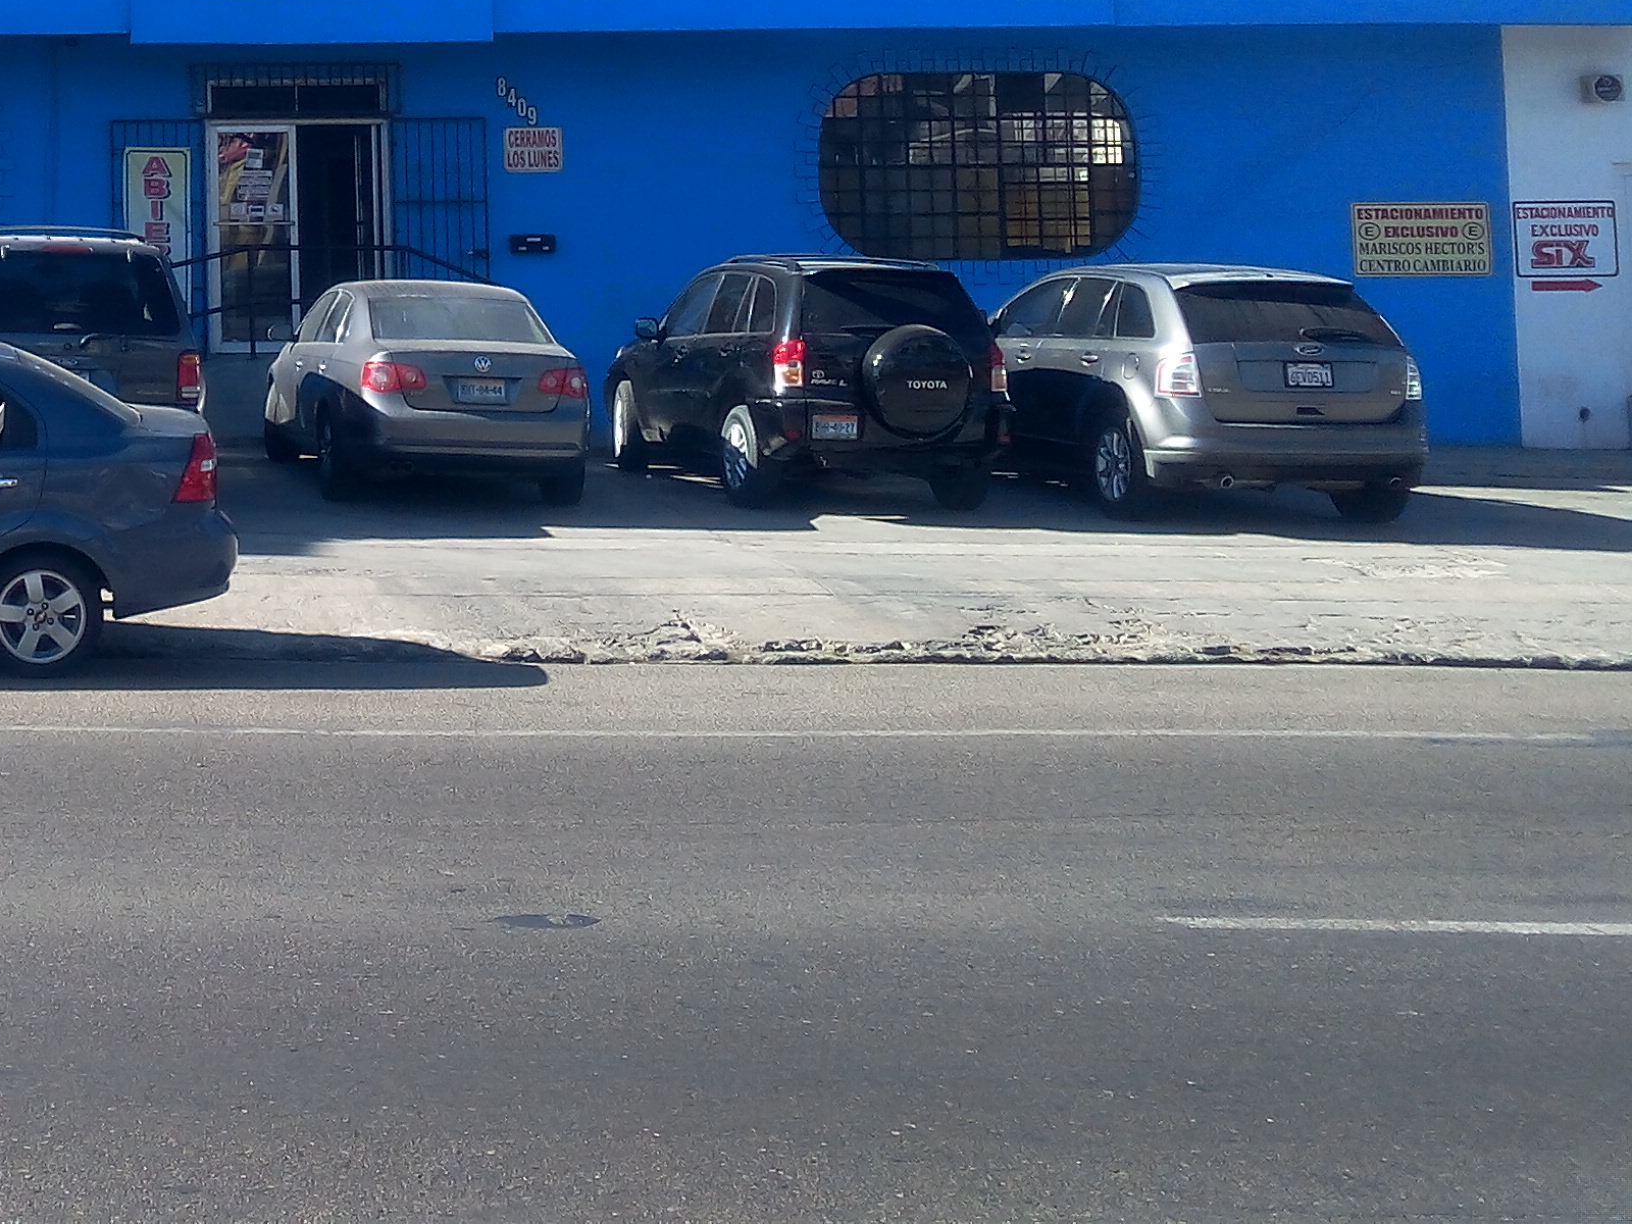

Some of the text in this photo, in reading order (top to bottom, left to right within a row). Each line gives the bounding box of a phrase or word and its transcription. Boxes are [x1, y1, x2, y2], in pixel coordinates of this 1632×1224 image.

[497, 76, 537, 126] 8409
[508, 129, 557, 149] CERRAMOS
[507, 150, 560, 168] LOS LUNES
[142, 156, 172, 256] ABIE
[1516, 206, 1614, 219] ESTACIONAMIENTO
[1357, 207, 1484, 220] ESTACIONAMIENTO
[1384, 225, 1459, 238] EXCLUSIVO
[1531, 224, 1599, 237] EXCLUSIVO
[1358, 242, 1485, 255] MARISCOS HECTOR'S
[1359, 259, 1486, 273] CENTRO CAMBIARIO
[906, 379, 948, 390] TOYOTA
